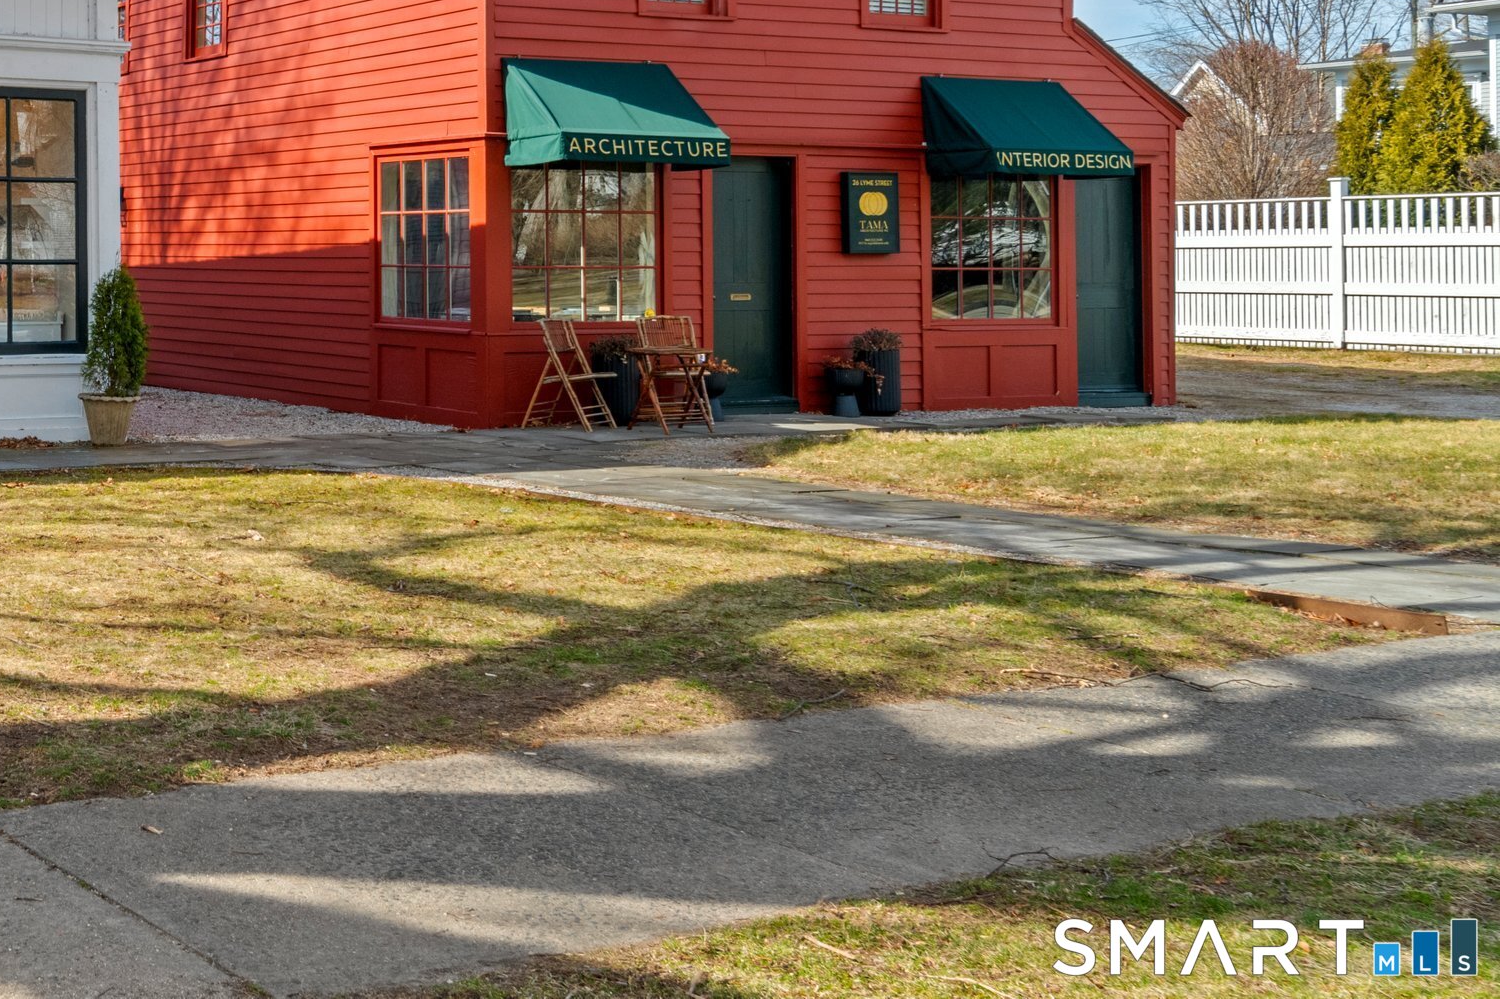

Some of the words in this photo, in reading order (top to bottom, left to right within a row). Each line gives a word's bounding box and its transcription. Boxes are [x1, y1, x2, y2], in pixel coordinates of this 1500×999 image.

[569, 137, 728, 158] ARCHITECTURE
[996, 151, 1071, 168] INTERIOR
[1075, 154, 1132, 169] DESIGN
[859, 220, 888, 230] TAMA
